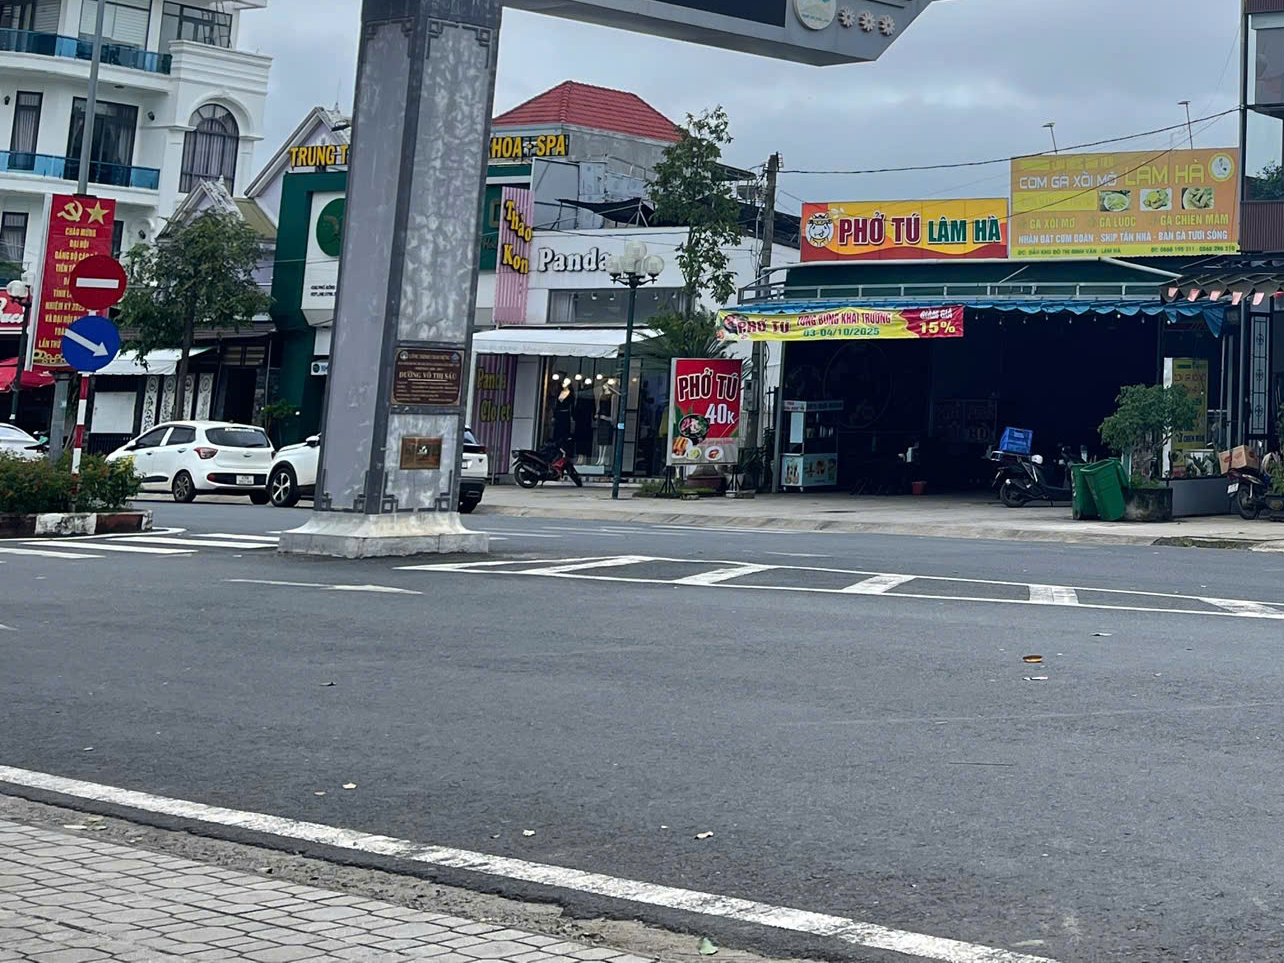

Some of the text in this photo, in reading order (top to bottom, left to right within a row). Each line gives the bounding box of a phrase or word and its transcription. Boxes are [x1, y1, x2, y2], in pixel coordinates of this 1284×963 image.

[289, 146, 335, 167] TRUNG
[488, 134, 568, 158] HOA SPA
[1175, 159, 1205, 184] HÀ
[838, 210, 1002, 245] PHỞ TÚ LÂM HÀ
[503, 244, 530, 274] Kon
[537, 246, 609, 273] Panda
[919, 320, 956, 334] 15%
[677, 367, 740, 402] PHỞ TÚ
